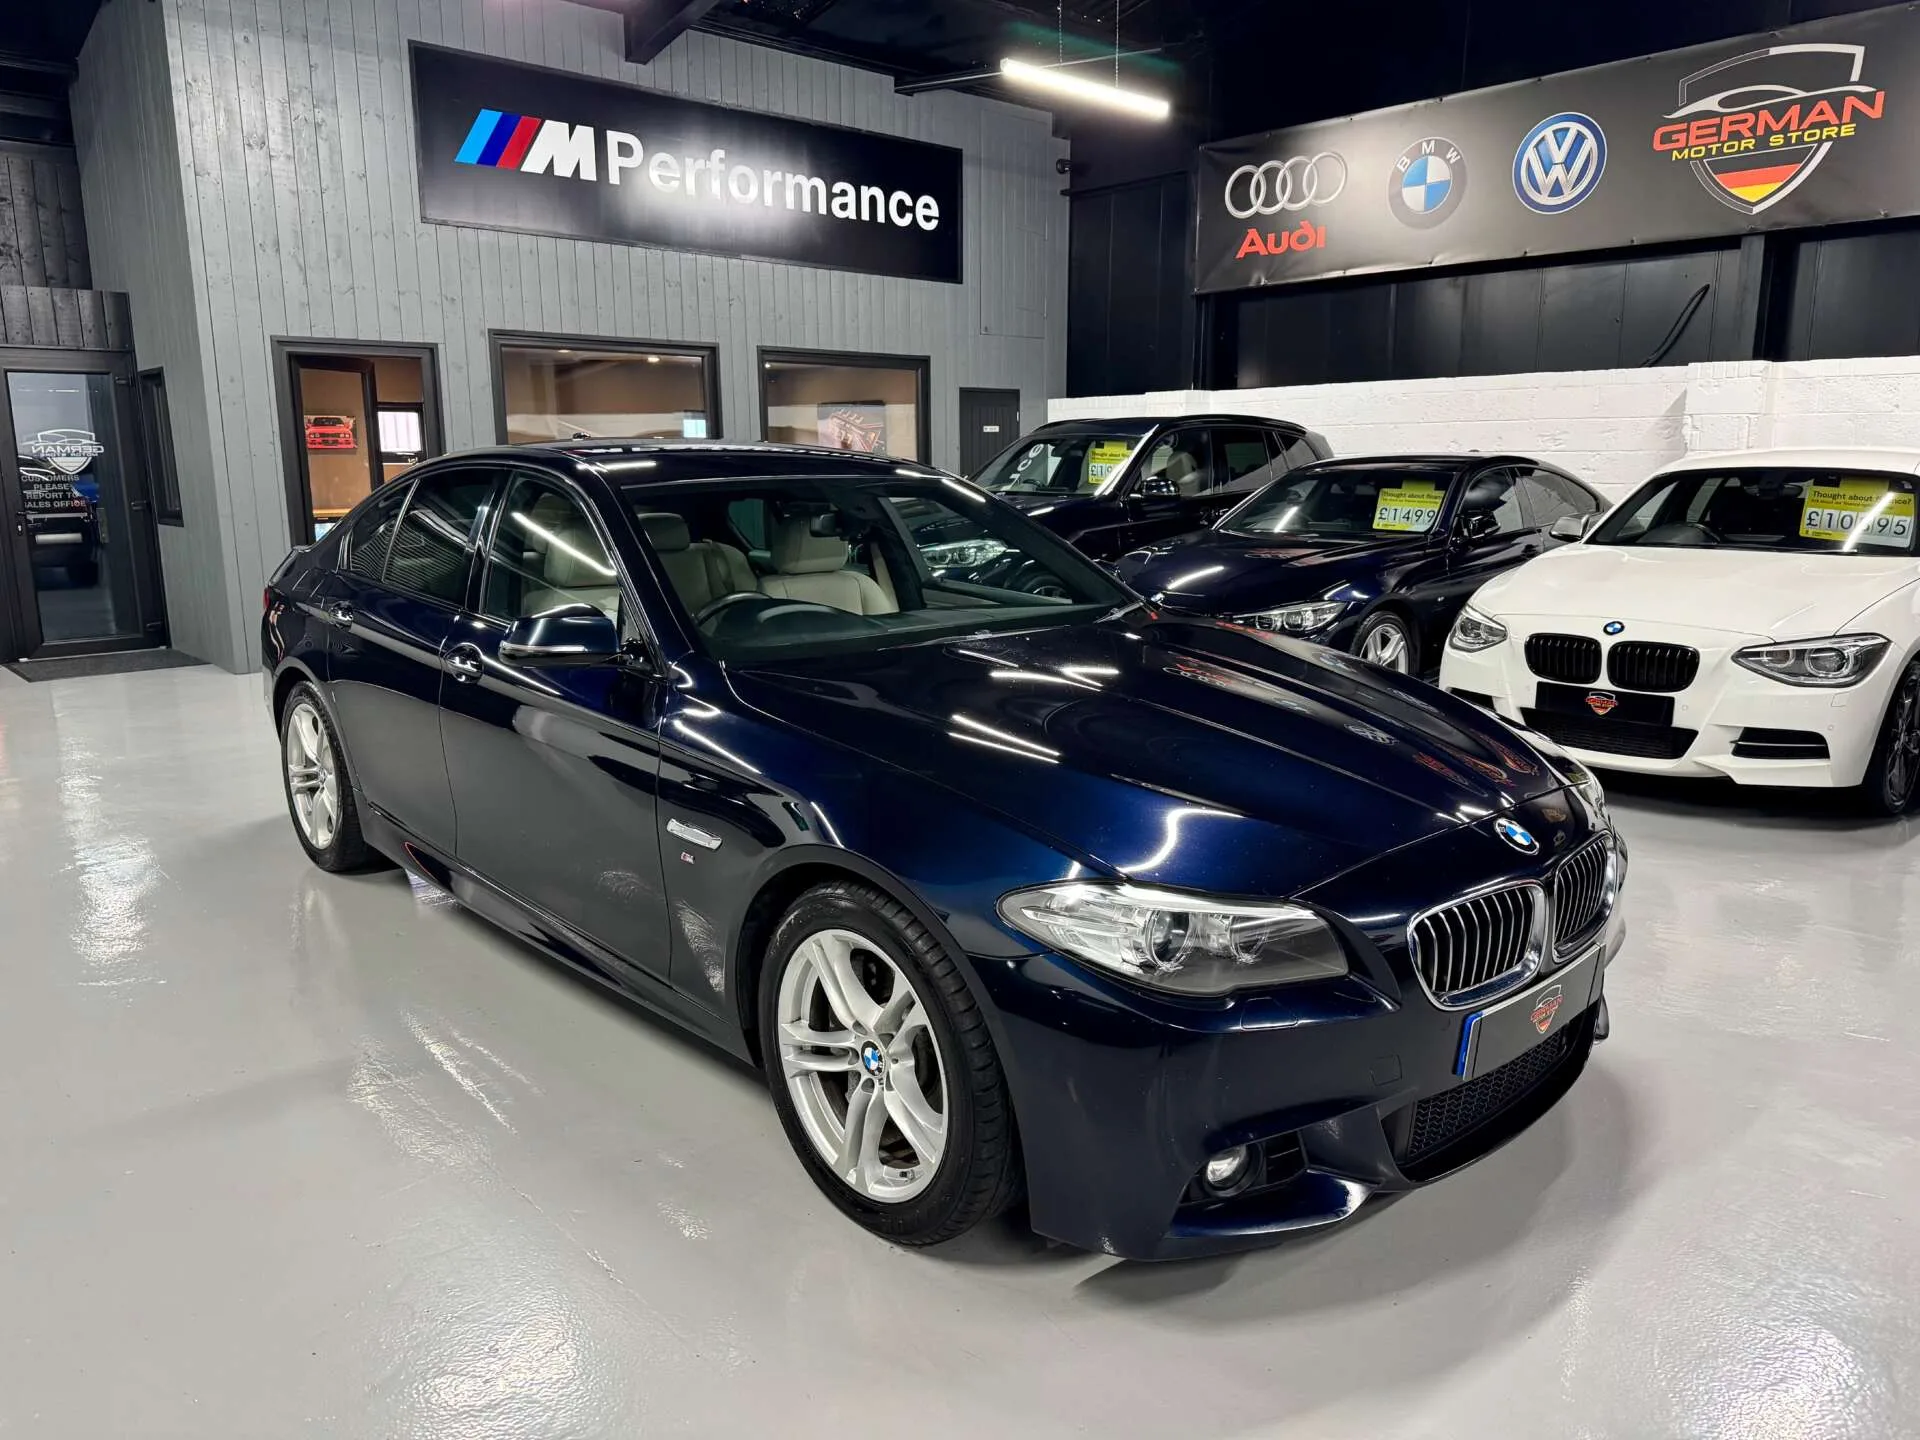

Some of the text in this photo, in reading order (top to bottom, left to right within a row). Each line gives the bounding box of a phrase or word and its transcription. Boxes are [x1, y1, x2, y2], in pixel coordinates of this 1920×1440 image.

[1653, 91, 1885, 151] GERMAN
[1672, 123, 1857, 161] MOTOR STORE
[606, 129, 939, 231] Performance
[1236, 220, 1326, 258] Audi
[25, 492, 62, 500] REPORT
[1813, 490, 1846, 501] Thought
[1848, 494, 1873, 502] about
[1378, 507, 1436, 523] £1499
[1806, 511, 1906, 535] £1095
